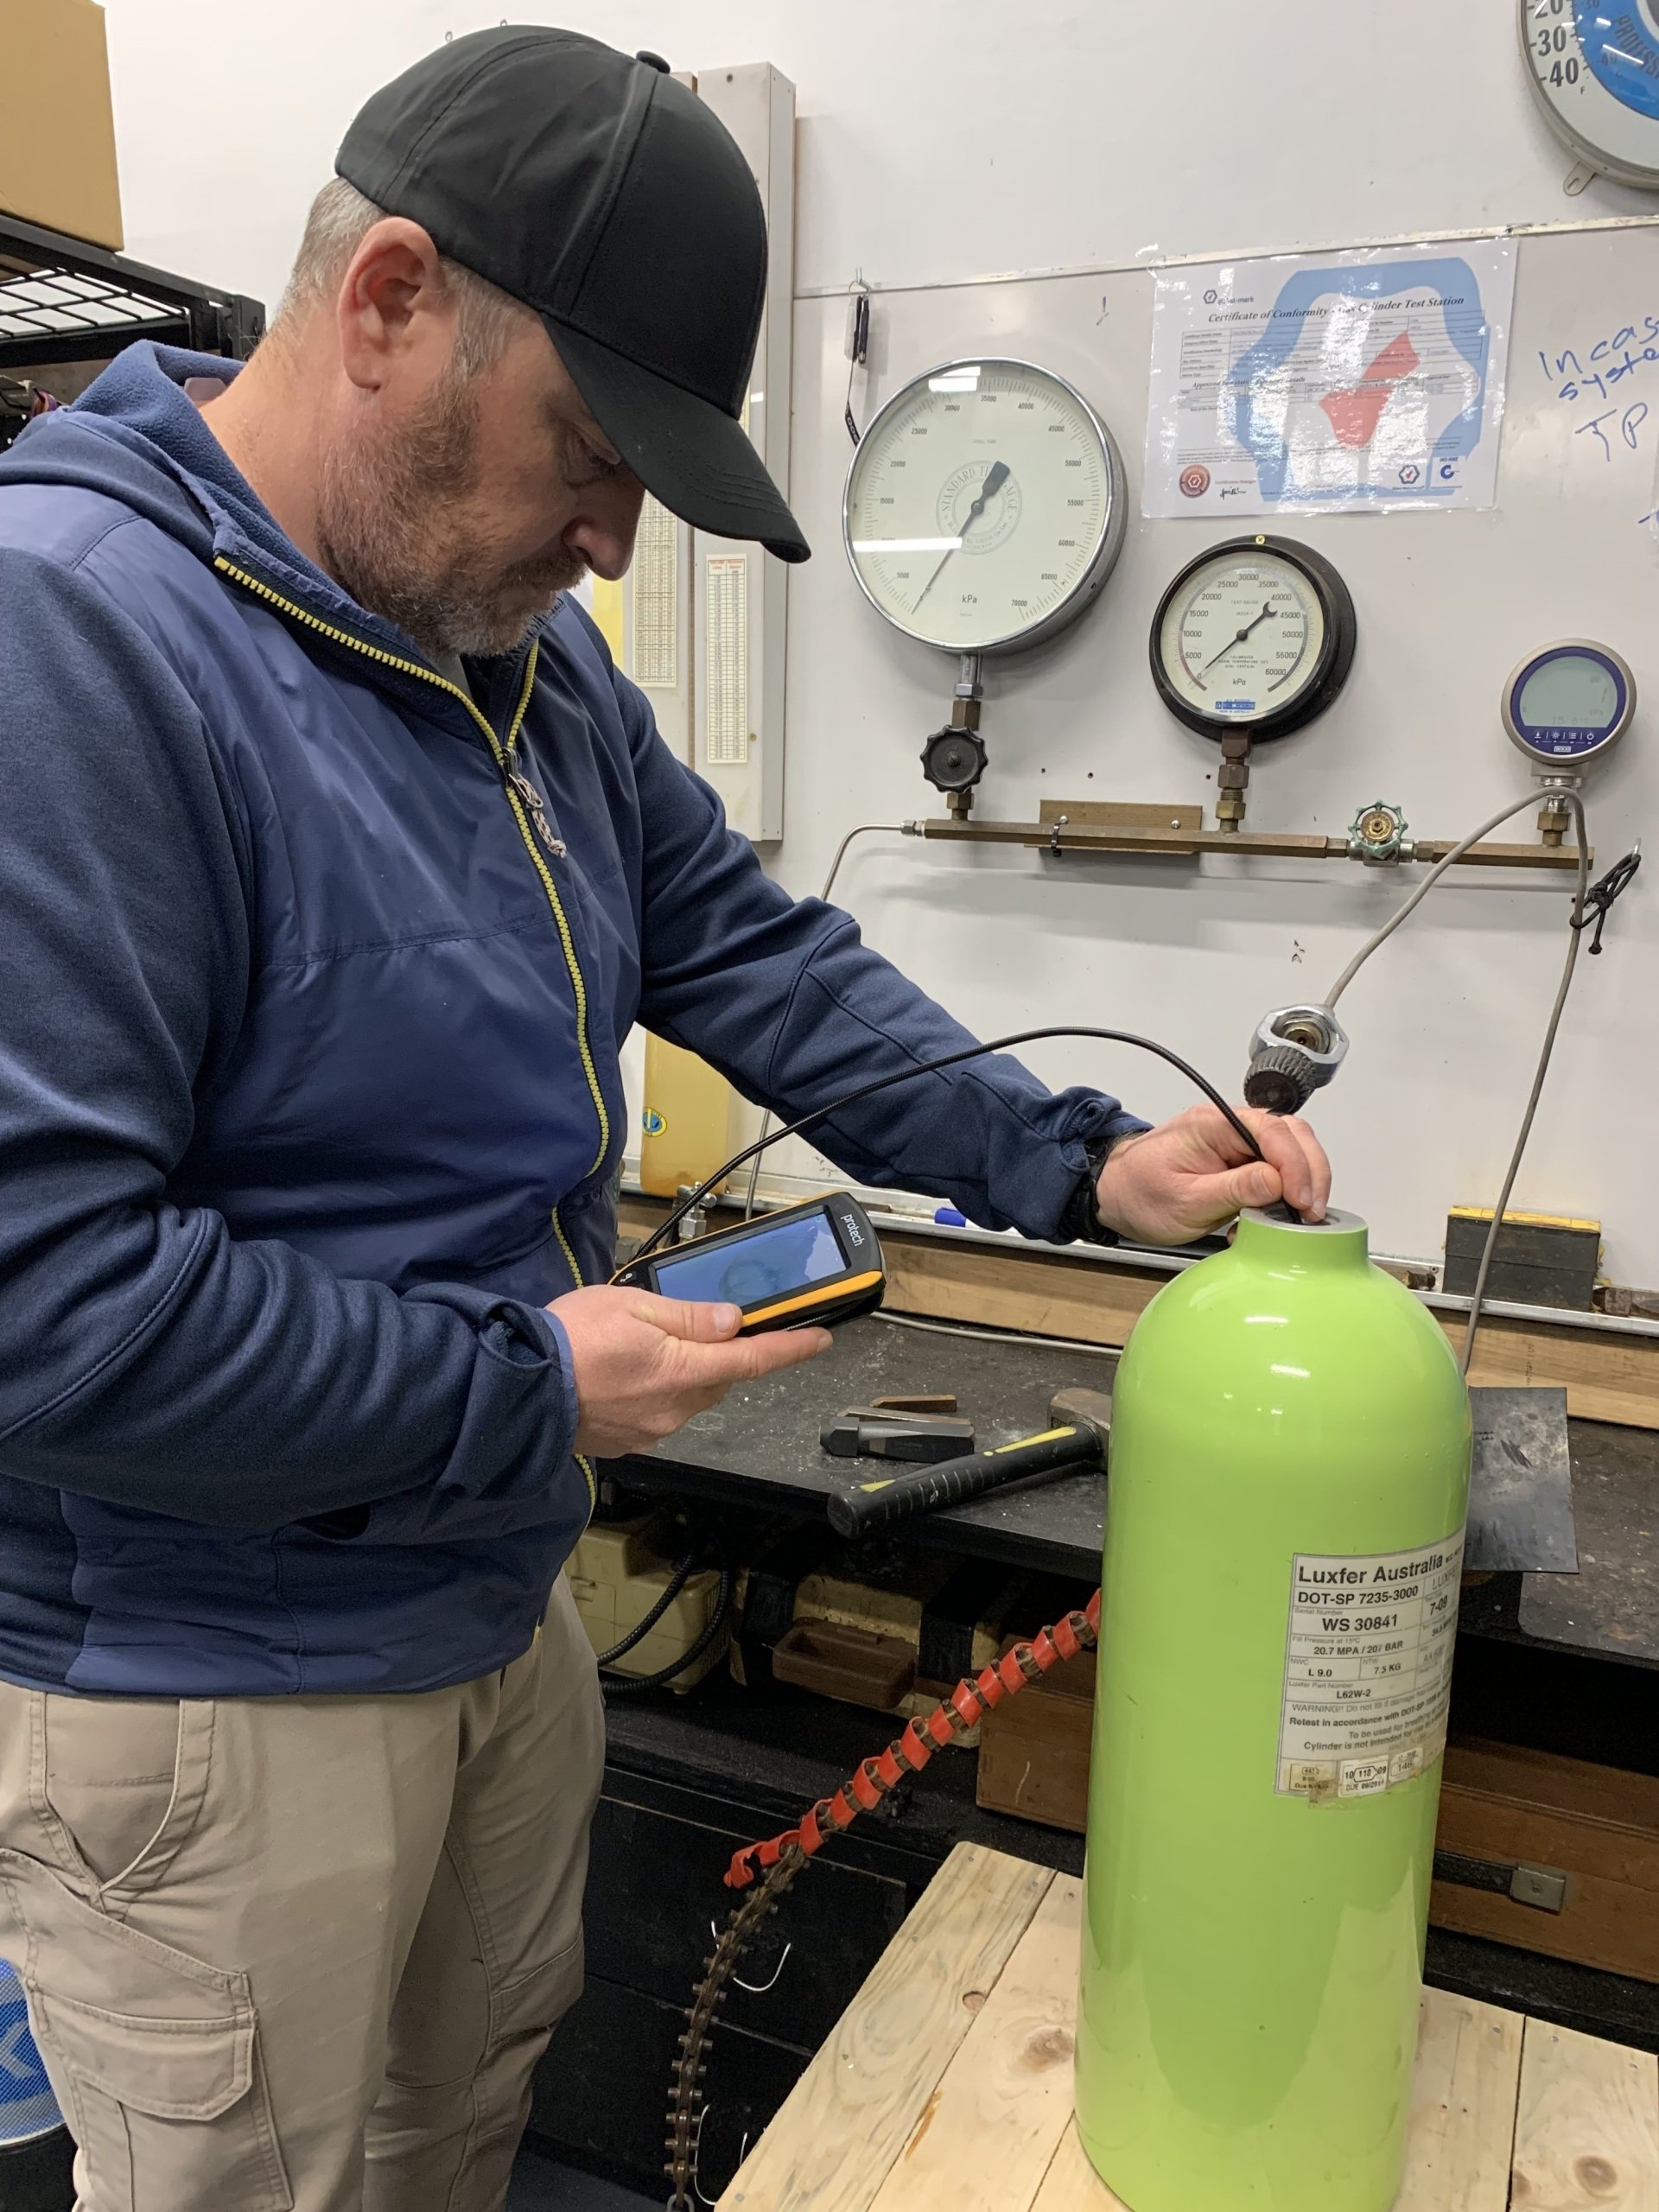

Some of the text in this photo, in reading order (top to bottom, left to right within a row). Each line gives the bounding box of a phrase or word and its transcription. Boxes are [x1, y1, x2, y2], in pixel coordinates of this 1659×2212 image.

[1538, 25, 1567, 57] 30
[1550, 57, 1579, 87] 40
[1209, 310, 1259, 322] Certificate
[1260, 308, 1274, 319] of
[1273, 306, 1329, 319] Conformity
[1405, 298, 1427, 308] Test
[1427, 296, 1465, 308] Station
[962, 594, 977, 603] kPa
[840, 1213, 865, 1247] protech
[1299, 1565, 1367, 1584] Luxfer
[1373, 1554, 1443, 1583] Australia
[1298, 1592, 1355, 1605] DOT-SP
[1359, 1585, 1419, 1605] 7235-3000
[1322, 1613, 1397, 1632] WS 30841
[1313, 1646, 1334, 1656] 20.7
[1337, 1646, 1359, 1656] MPA
[1384, 1641, 1403, 1651] BAR
[1374, 1663, 1401, 1675] 75 KG
[1336, 1689, 1371, 1700] L62W-2
[1289, 1717, 1319, 1726] Retest
[1323, 1718, 1331, 1726] in
[1333, 1715, 1382, 1726] accordance
[1384, 1712, 1399, 1721] with
[1402, 1702, 1425, 1718] DOT-SP
[1373, 1727, 1391, 1737] used
[1393, 1723, 1403, 1732] for
[1304, 1742, 1343, 1751] Cylinder
[1344, 1741, 1352, 1750] is
[1355, 1740, 1369, 1749] not
[1345, 1783, 1359, 1791] DUE
